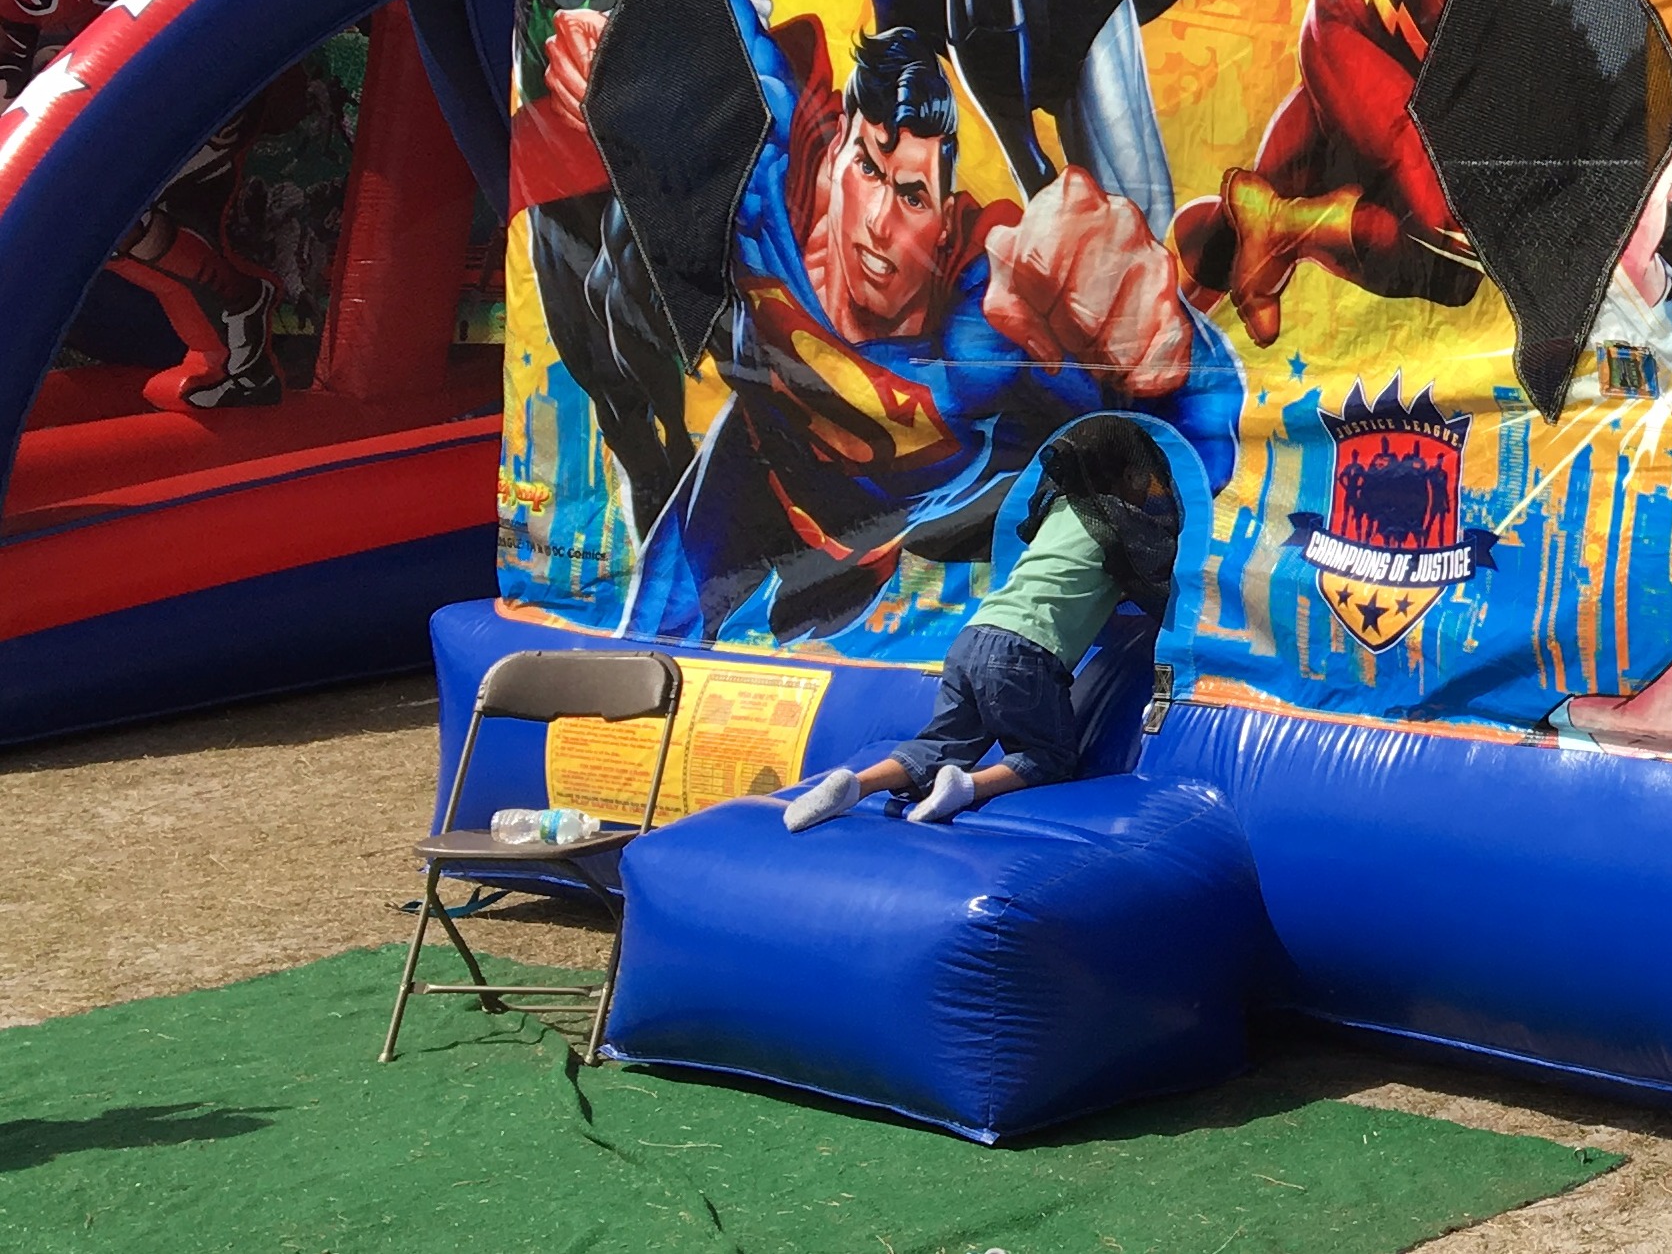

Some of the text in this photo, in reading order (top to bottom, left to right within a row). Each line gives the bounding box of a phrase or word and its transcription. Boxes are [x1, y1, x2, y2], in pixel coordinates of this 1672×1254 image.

[1335, 417, 1461, 447] JUSTICE LEAGUE
[1305, 530, 1472, 583] CHAMPIONS OF JUSTICE
